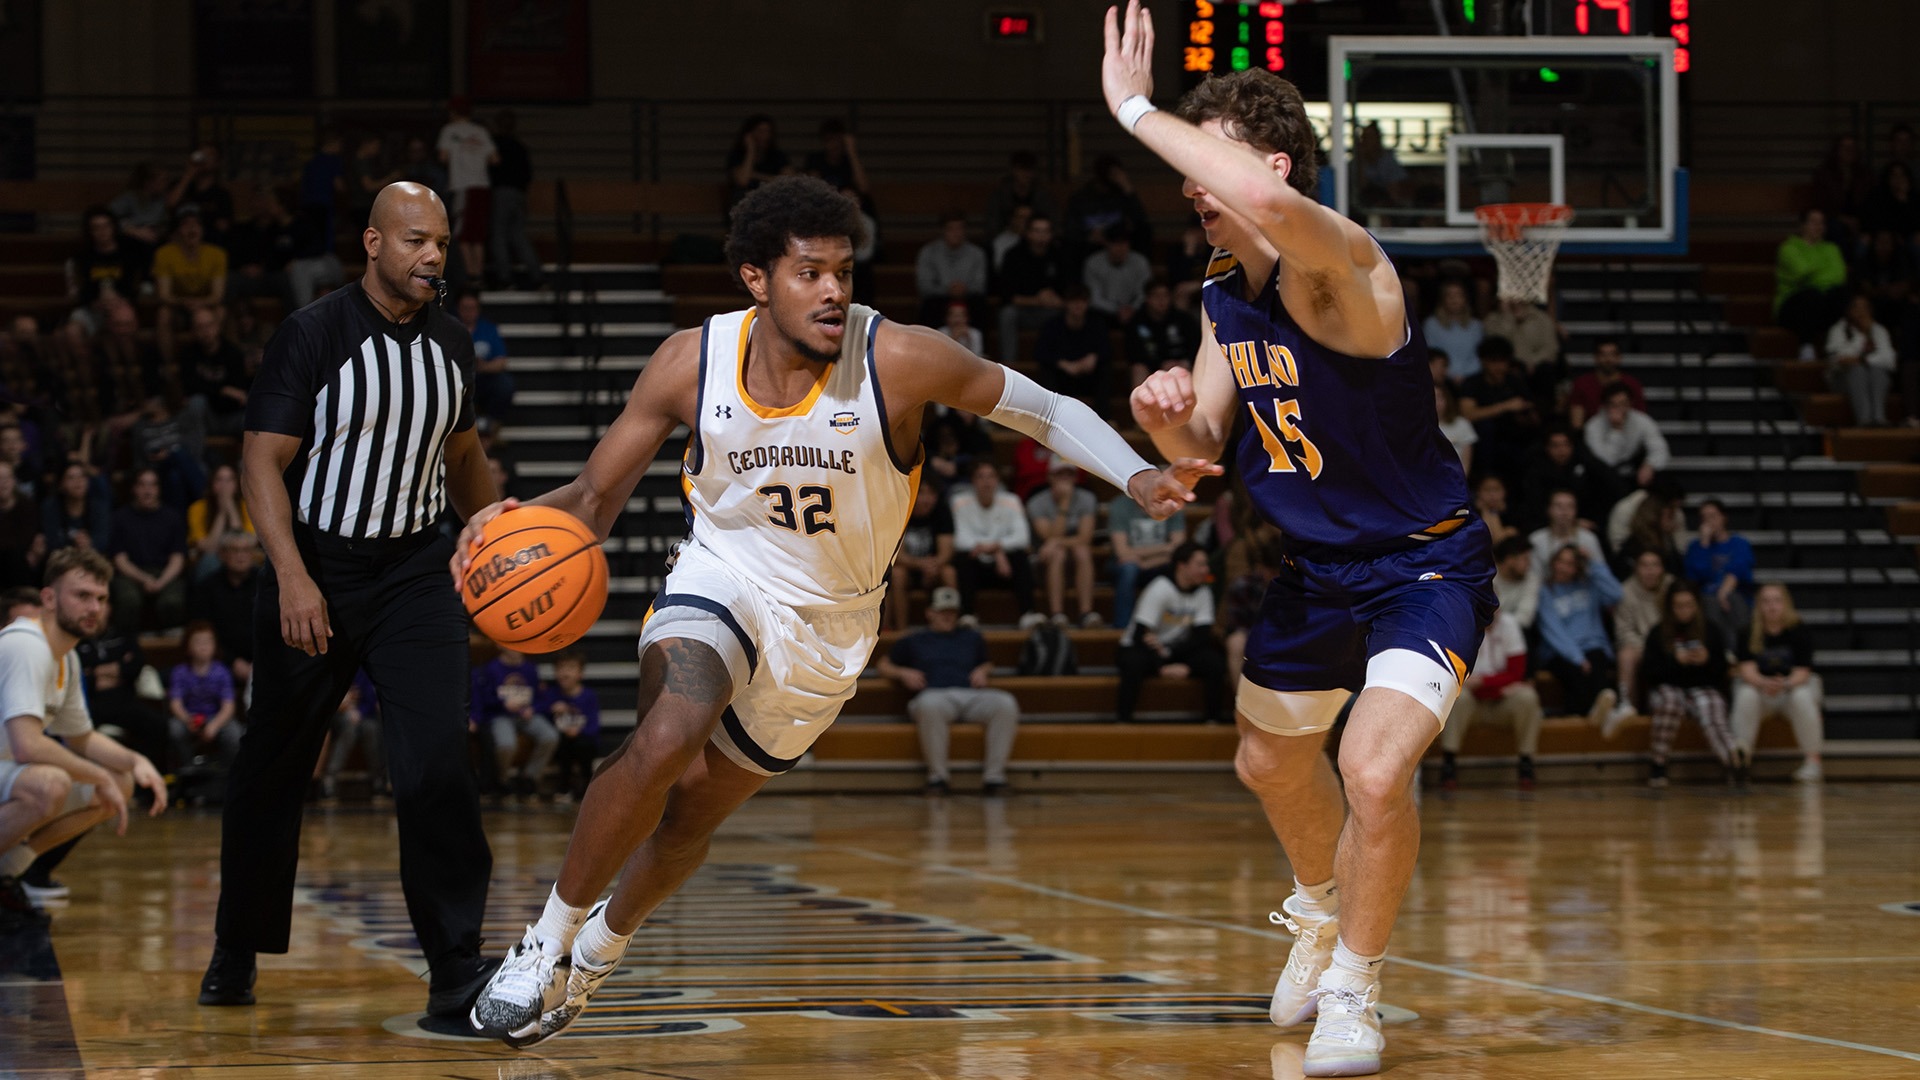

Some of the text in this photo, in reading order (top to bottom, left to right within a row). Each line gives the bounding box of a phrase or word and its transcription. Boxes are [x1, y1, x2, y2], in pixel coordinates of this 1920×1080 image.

[1184, 47, 1214, 71] 32
[1266, 47, 1284, 71] 5
[727, 445, 857, 475] CEDARVILLE
[1247, 398, 1324, 480] 15
[756, 482, 838, 538] 32
[466, 542, 553, 600] Wilson
[504, 591, 554, 631] EVO
